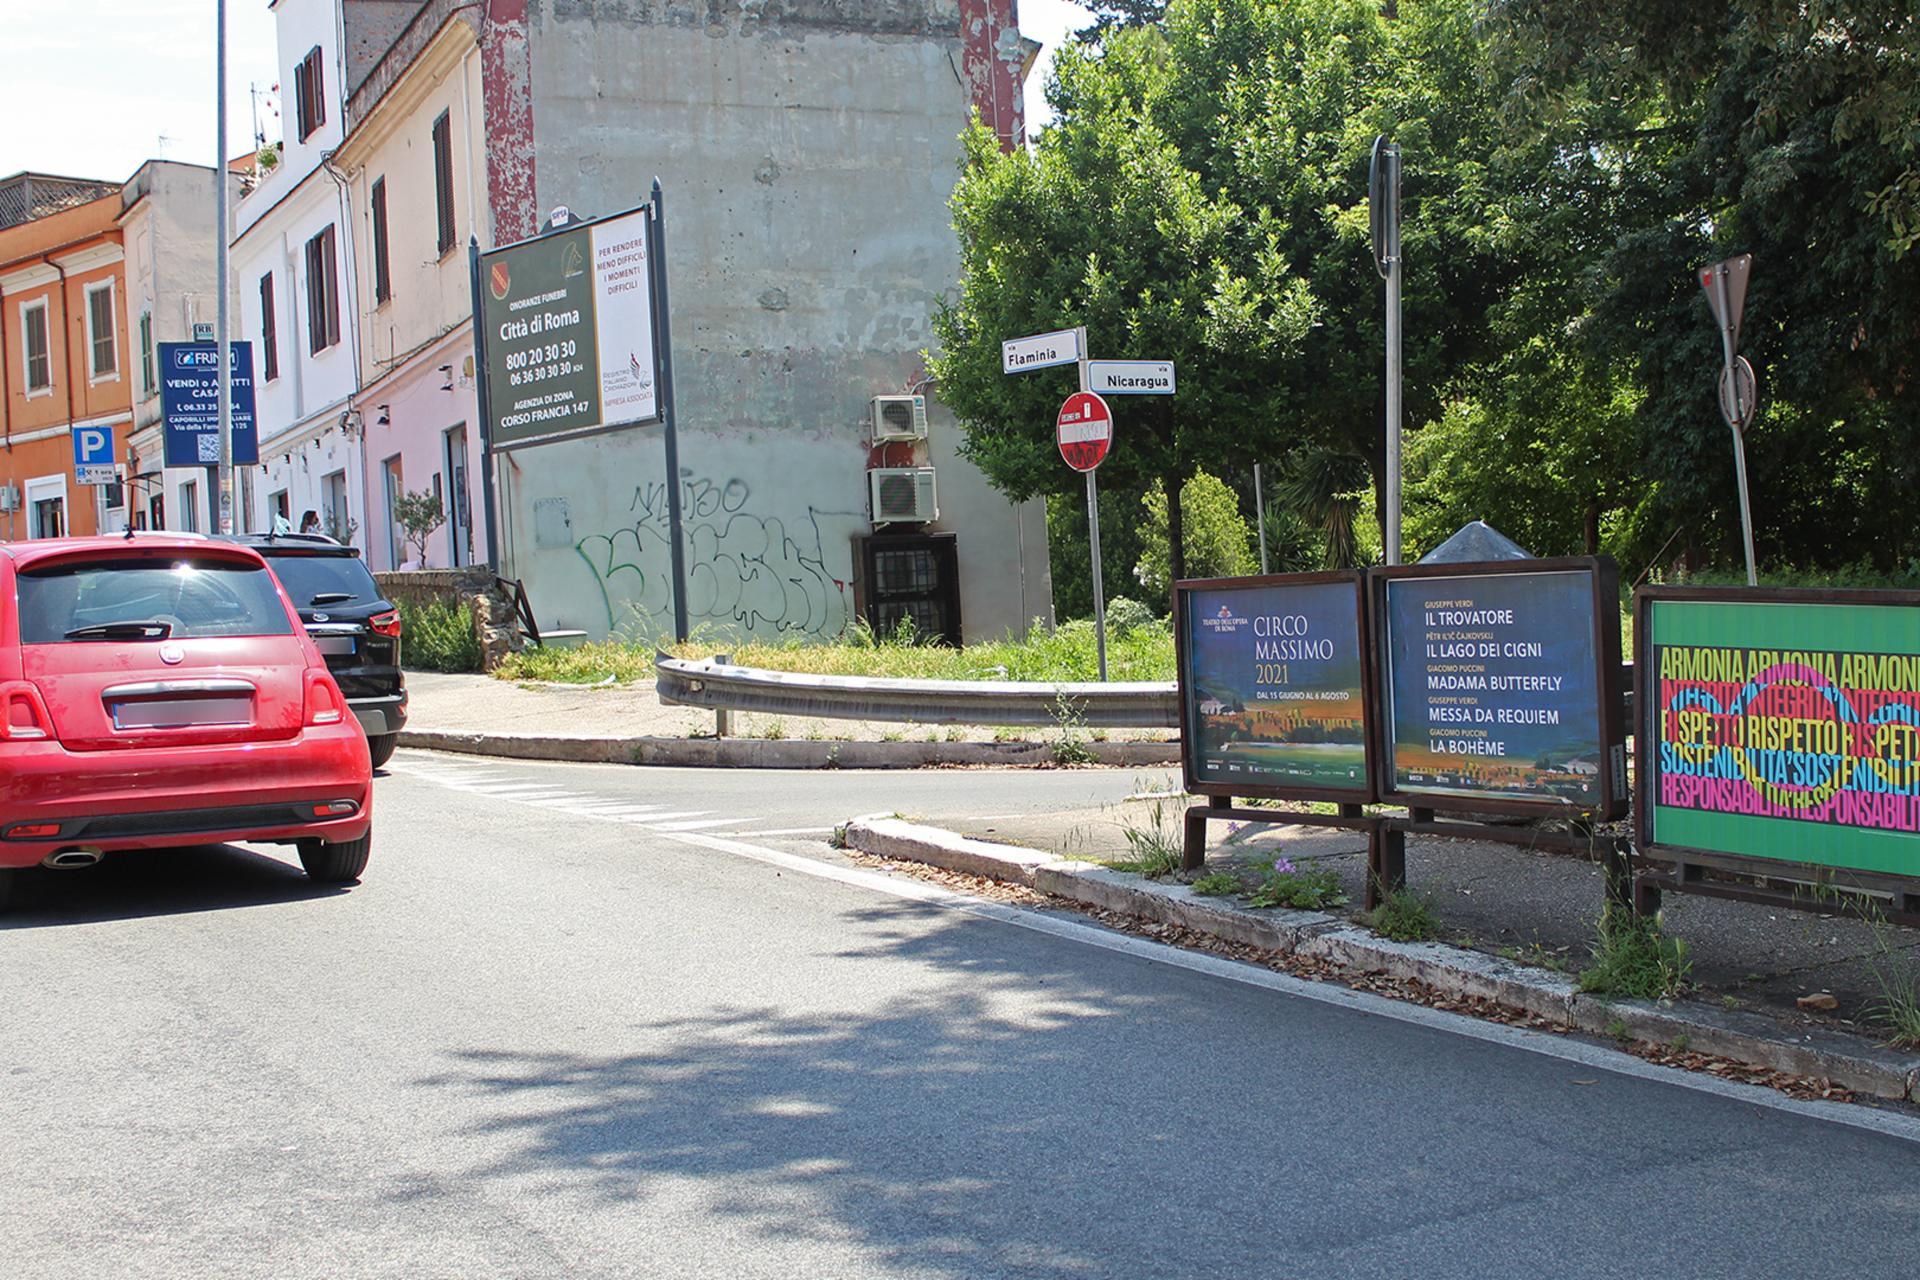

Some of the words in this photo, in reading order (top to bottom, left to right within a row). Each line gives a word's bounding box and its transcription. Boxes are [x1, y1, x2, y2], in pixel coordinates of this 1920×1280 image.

[599, 248, 611, 257] PER
[612, 239, 643, 254] RENDERE
[597, 259, 616, 270] MENO
[617, 251, 646, 266] DIFFICILI
[608, 266, 640, 281] MOMENTI
[608, 280, 638, 295] DIFFICILI
[509, 296, 542, 311] ONORANZE
[542, 289, 567, 303] FUNEBRI
[500, 318, 528, 340] Città
[530, 315, 543, 333] di
[544, 310, 580, 331] Roma
[506, 351, 527, 370] 800
[528, 347, 543, 365] 20
[544, 344, 559, 361] 30
[561, 339, 576, 358] 30
[1008, 349, 1057, 366] Flaminia
[510, 372, 521, 386] 06
[522, 369, 533, 383] 36
[535, 367, 546, 381] 30
[547, 364, 558, 378] 30
[560, 361, 571, 375] 30
[166, 379, 199, 388] VENDI
[1107, 375, 1169, 390] Nicaragua
[183, 403, 206, 411] 06.33
[207, 403, 218, 411] 25
[514, 397, 544, 410] AGENZIA
[544, 394, 553, 404] DI
[554, 390, 574, 403] ZONA
[168, 416, 206, 424] CAPORILLI
[501, 413, 531, 427] CORSO
[532, 404, 571, 422] FRANCIA
[572, 401, 589, 414] 147
[81, 430, 105, 462] P
[1424, 600, 1454, 609] GIUSEPPE
[1455, 600, 1473, 608] VERDI
[1203, 618, 1220, 626] TEATRO
[1253, 614, 1309, 637] CIRCO
[1425, 612, 1436, 626] IL
[1438, 609, 1514, 626] TROVATORE
[1255, 638, 1334, 661] MASSIMO
[1426, 643, 1438, 658] IL
[1440, 643, 1476, 658] LAGO
[1479, 643, 1500, 657] DEI
[1503, 642, 1542, 657] CIGNI
[1255, 663, 1289, 685] 2021
[1427, 664, 1459, 673] GIACOMO
[1459, 664, 1485, 673] PUCCINI
[1660, 646, 1745, 683] ARMONIA
[1746, 650, 1838, 688] ARMONIA
[1427, 675, 1488, 690] MADAMA
[1490, 676, 1562, 691] BUTTERFLY
[1256, 691, 1269, 700] DAL
[1270, 691, 1278, 700] 15
[1279, 691, 1305, 700] GIUGNO
[1306, 691, 1314, 700] AL
[1321, 691, 1350, 700] AGOSTO
[1428, 696, 1457, 705] GIUSEPPE
[1459, 697, 1478, 705] VERDI
[1429, 707, 1472, 722] MESSA
[1475, 708, 1495, 722] DA
[1497, 709, 1560, 725] REQUIEM
[1428, 728, 1461, 737] GIACOMO
[1461, 729, 1488, 738] PUCCINI
[1661, 709, 1745, 747] RISPETTO
[1747, 714, 1838, 756] RISPETTO
[1430, 739, 1446, 754] LA
[1449, 737, 1505, 756] BOHÈME
